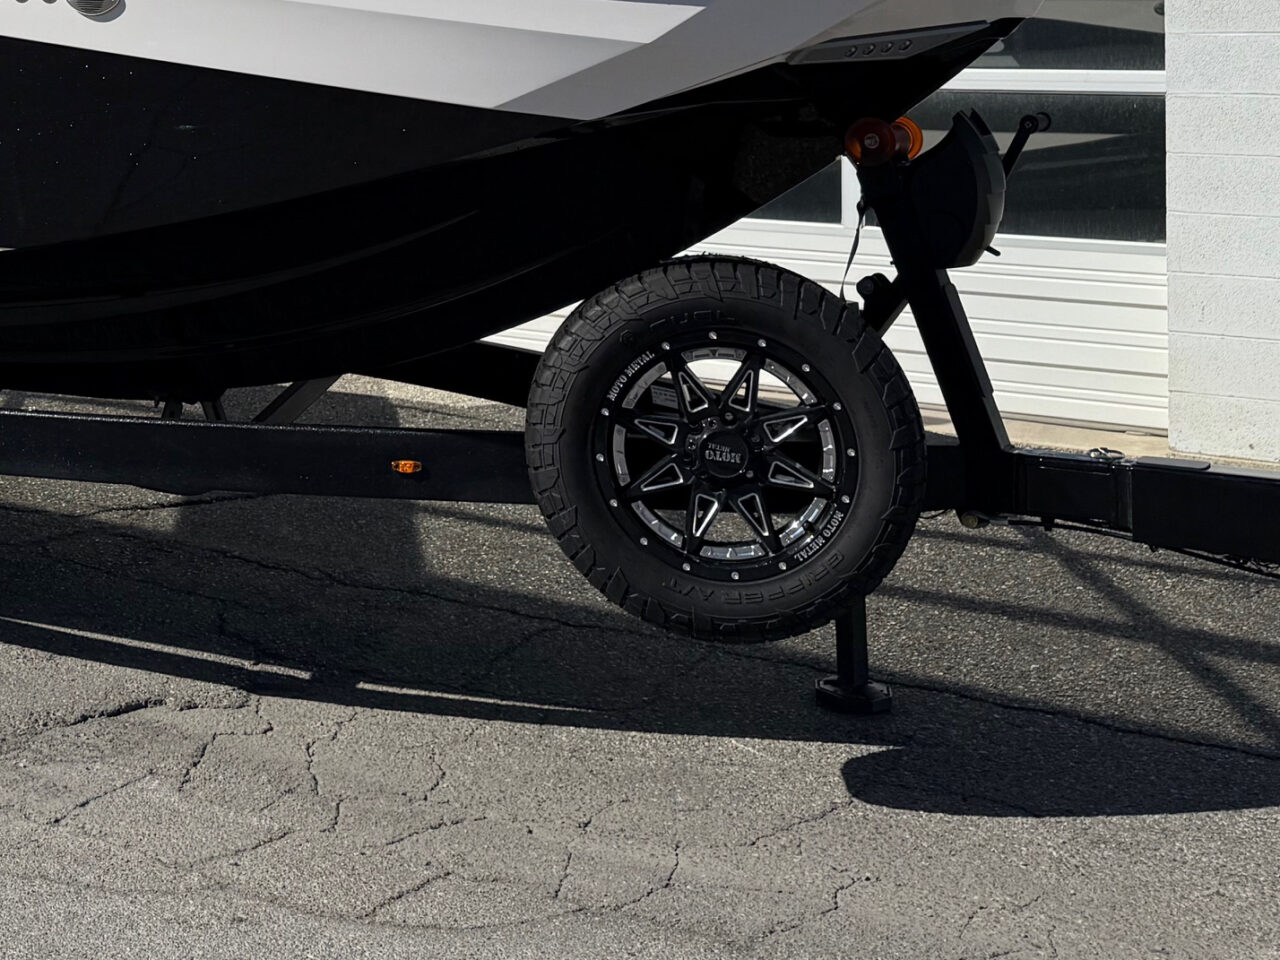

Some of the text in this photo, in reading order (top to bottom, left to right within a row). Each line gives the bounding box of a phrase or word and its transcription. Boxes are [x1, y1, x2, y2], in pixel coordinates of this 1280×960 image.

[606, 350, 656, 401] MOTO METAL
[705, 449, 741, 464] MOTO
[793, 510, 844, 561] MOTO METAL
